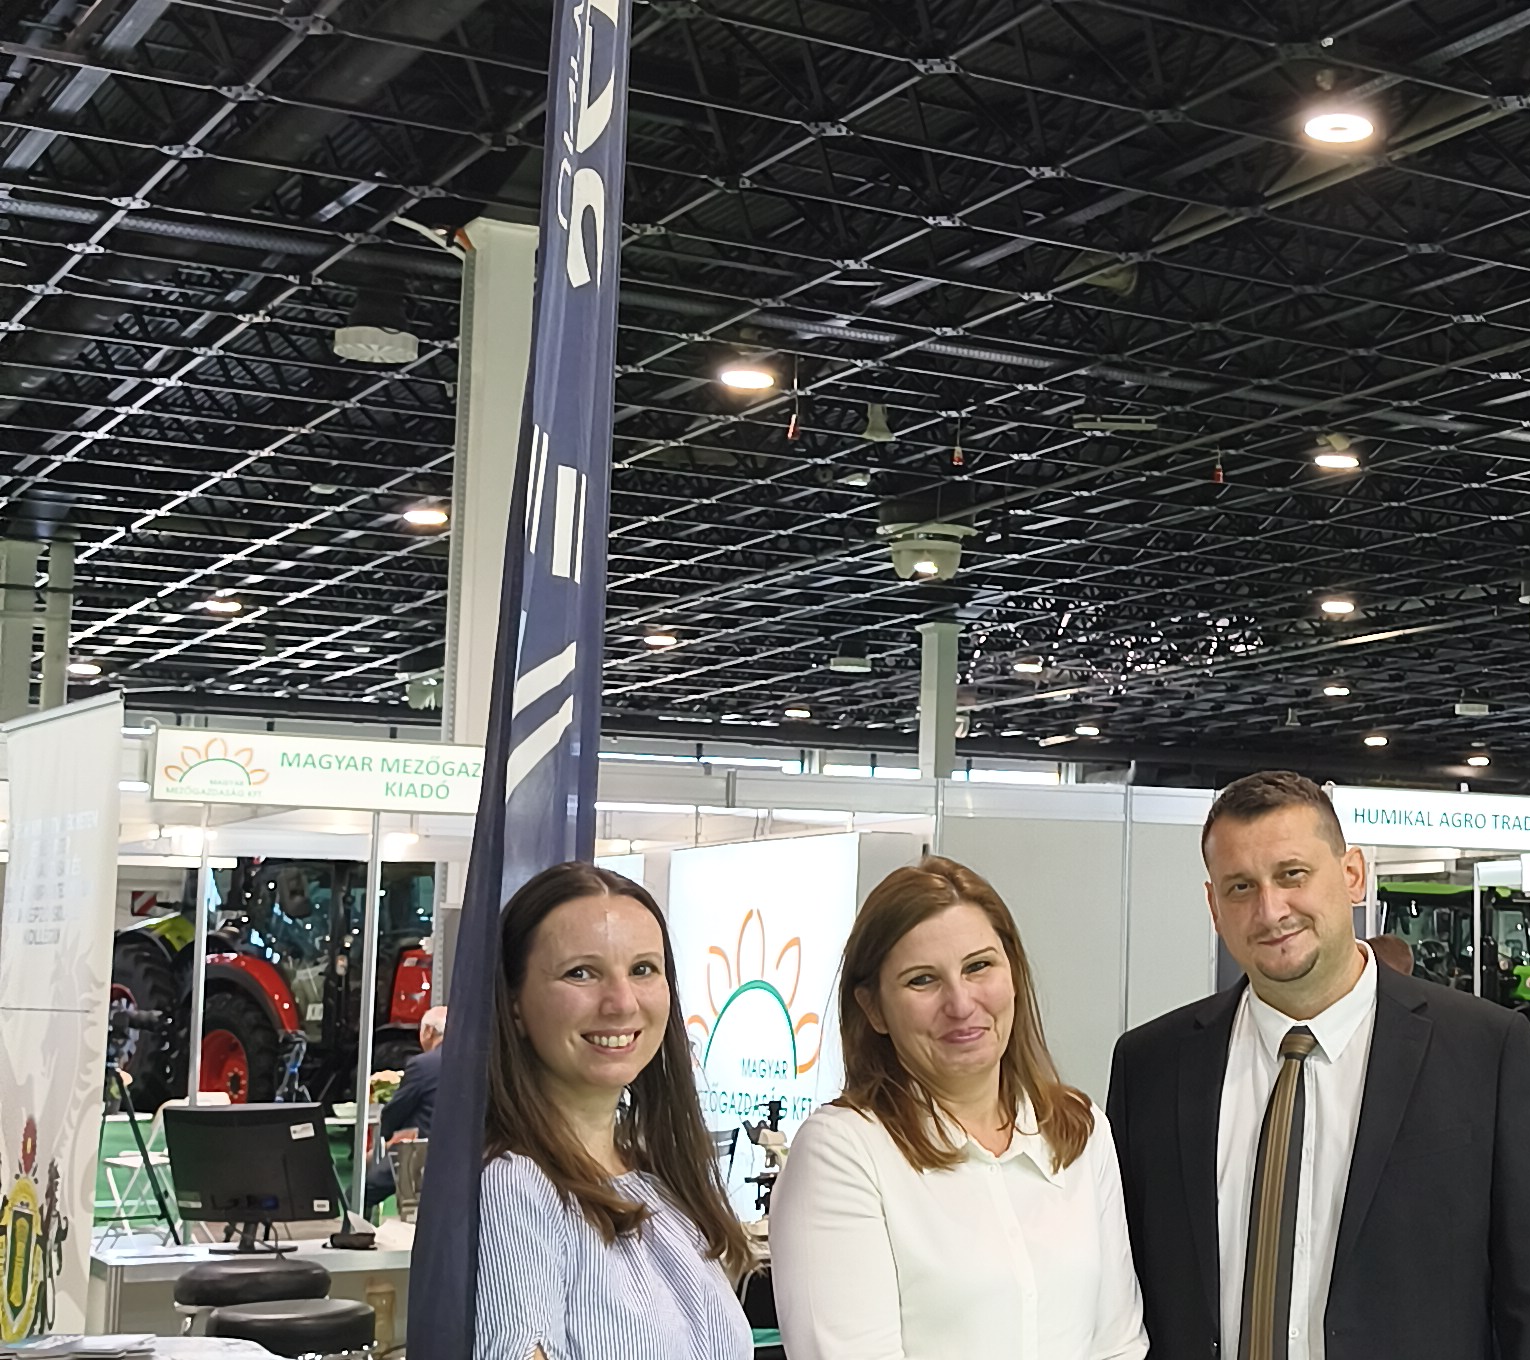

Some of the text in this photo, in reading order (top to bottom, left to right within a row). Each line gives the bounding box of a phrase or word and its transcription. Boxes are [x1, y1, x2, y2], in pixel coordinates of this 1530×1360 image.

[280, 751, 483, 778] MAGYAR MEZŐGAZ
[384, 779, 450, 801] KIADÓ
[1354, 807, 1434, 828] HUMIKAL
[1439, 812, 1487, 829] AGRO
[741, 1057, 789, 1080] MAGYAR
